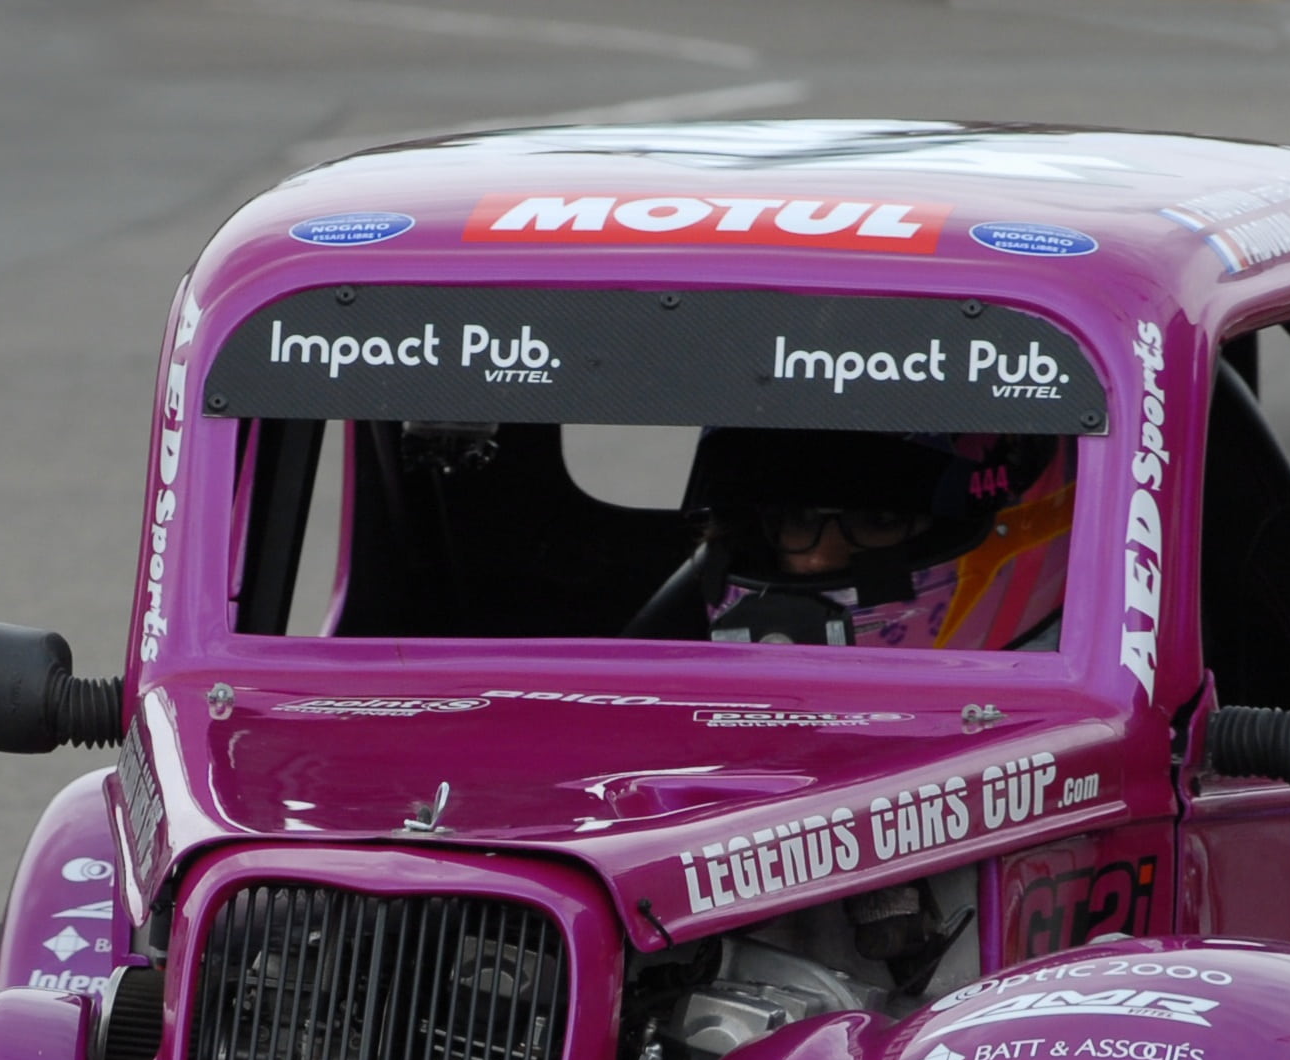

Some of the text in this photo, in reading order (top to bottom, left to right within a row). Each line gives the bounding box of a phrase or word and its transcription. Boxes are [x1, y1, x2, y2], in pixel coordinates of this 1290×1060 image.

[311, 222, 391, 234] NOGARO
[490, 196, 923, 239] MOTUL
[312, 233, 346, 242] ESSAIS
[347, 232, 375, 240] LIBRE
[992, 231, 1074, 247] NOGARO
[994, 240, 1029, 250] ESSAIS
[1030, 243, 1059, 253] LIBRE
[270, 319, 561, 379] Impact Pub.
[773, 335, 1070, 394] Impact Pub.
[484, 369, 554, 384] VITTEL
[991, 385, 1062, 399] VITTEL
[140, 291, 204, 663] AED Sports
[969, 464, 1009, 499] 444
[1119, 319, 1170, 707] AED Sports
[680, 751, 1100, 914] LEGENDS CARS CUP .com
[937, 960, 1234, 1010] Optic 2000
[1049, 1040, 1070, 1057] &
